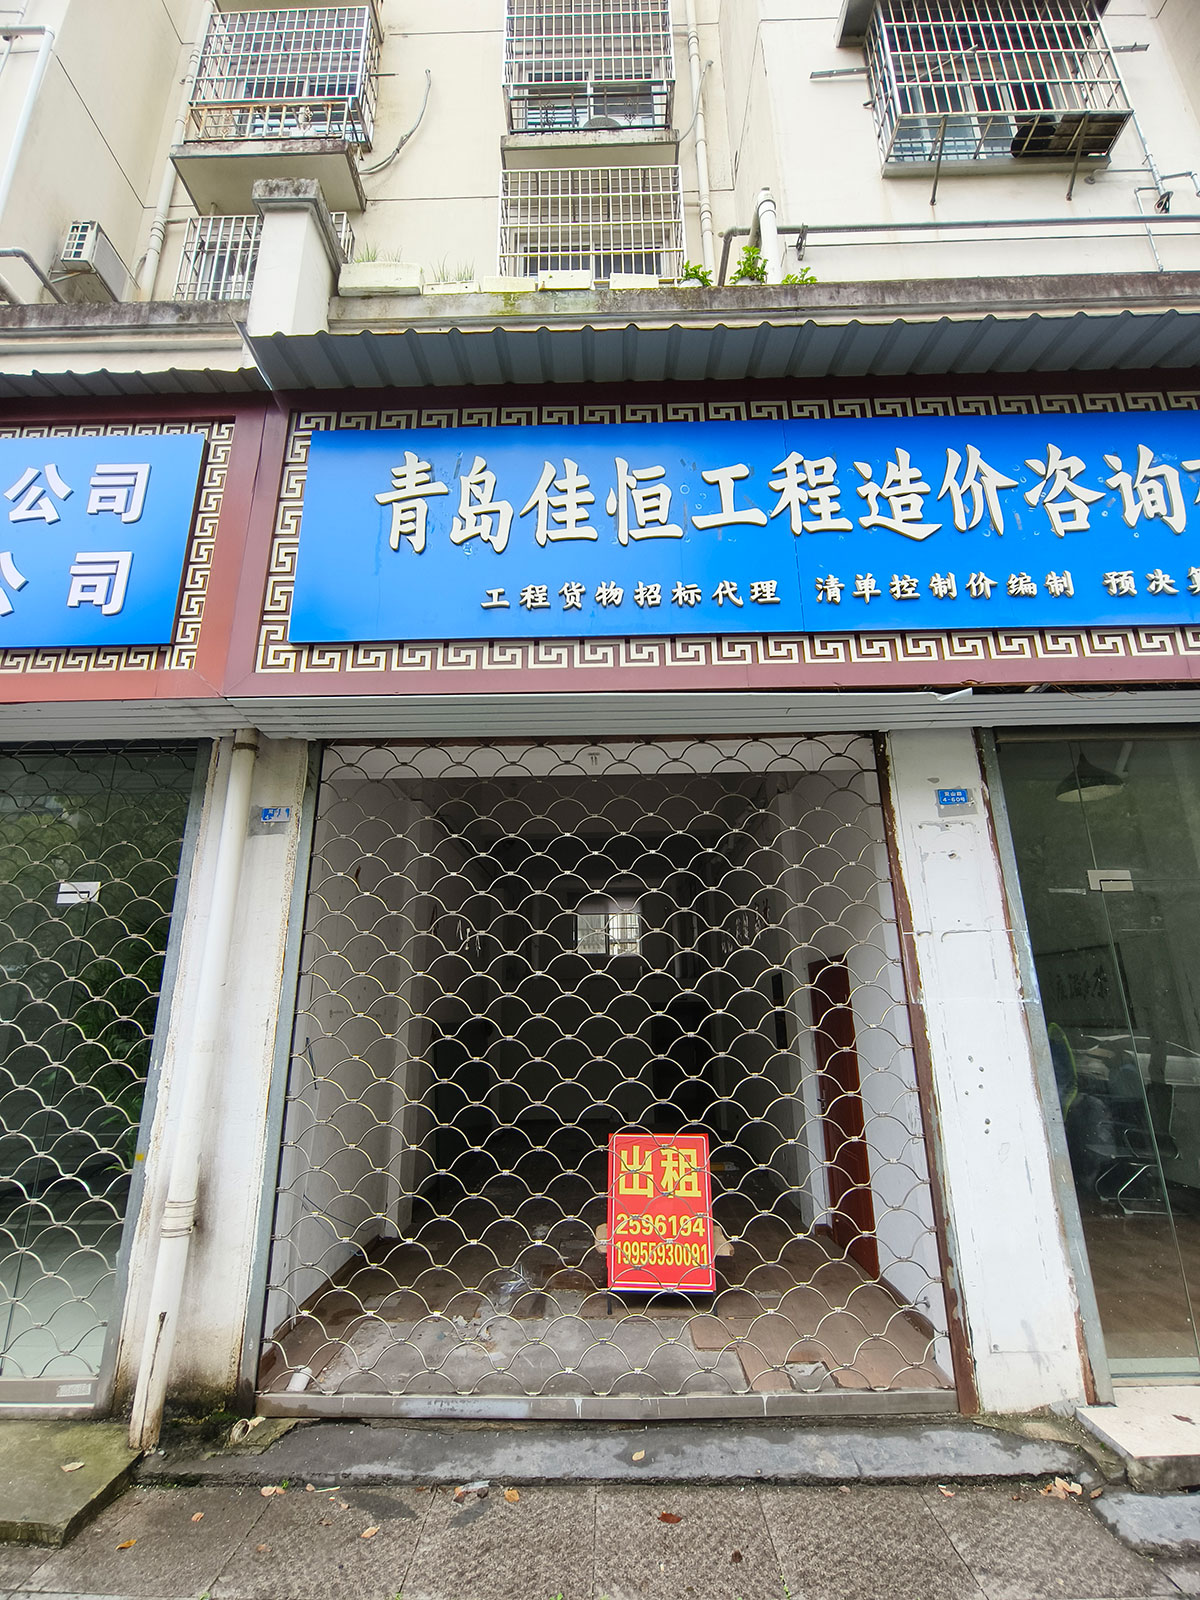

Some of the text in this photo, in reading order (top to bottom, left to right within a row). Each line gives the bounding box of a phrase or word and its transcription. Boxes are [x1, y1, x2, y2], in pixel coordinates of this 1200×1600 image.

[3, 463, 153, 525] 公司
[480, 579, 781, 611] 工程货物招标代理
[815, 570, 1076, 604] 清单控制价编制
[618, 1145, 702, 1199] 出租
[615, 1213, 706, 1238] 2596194
[615, 1240, 708, 1267] 19955930091
